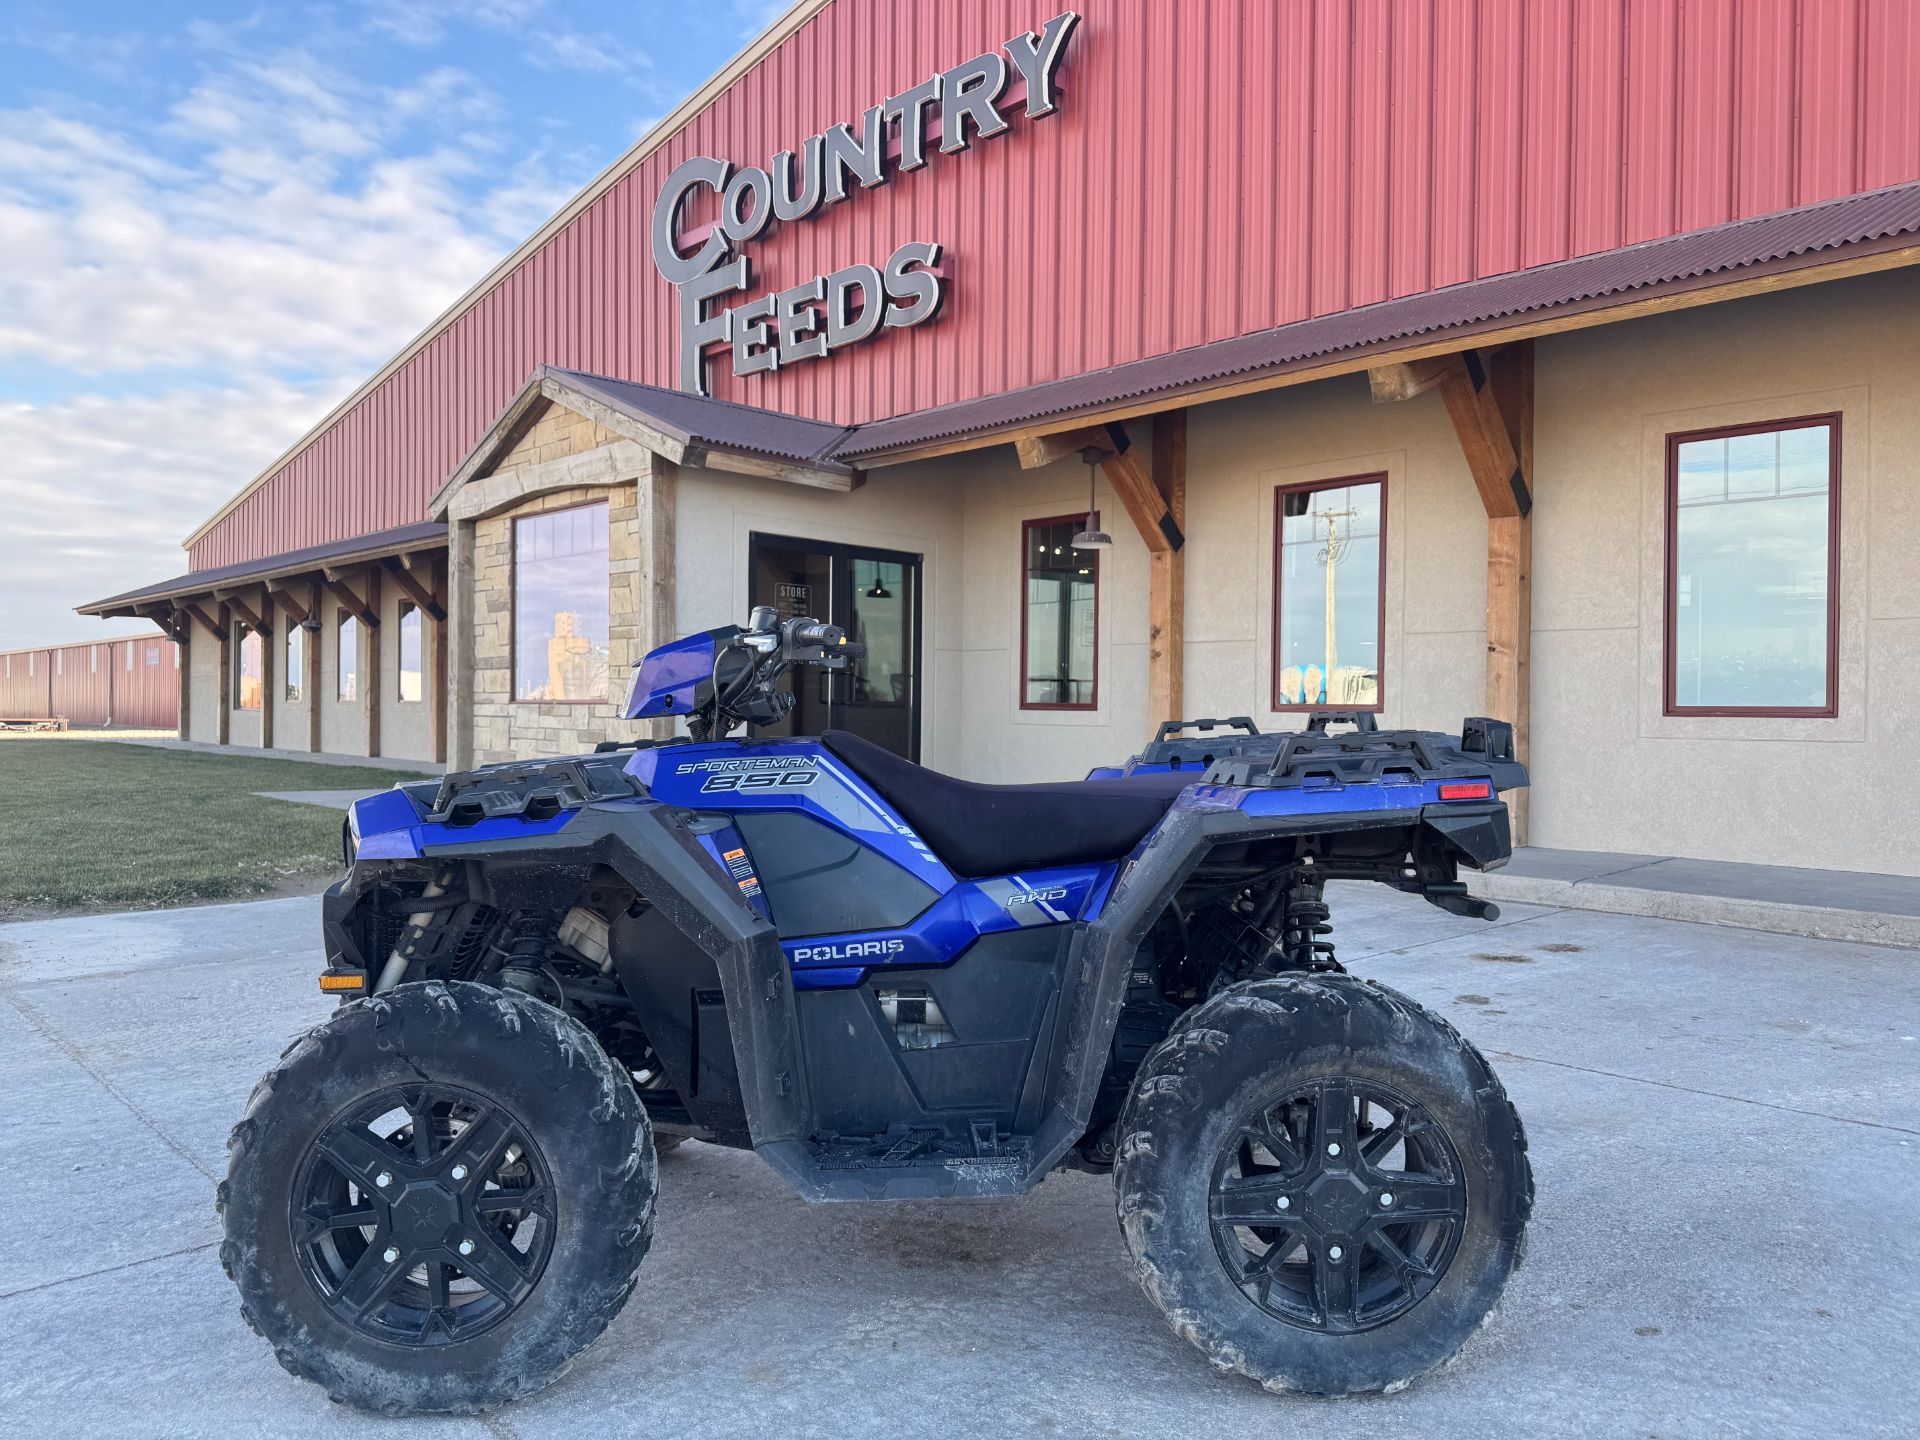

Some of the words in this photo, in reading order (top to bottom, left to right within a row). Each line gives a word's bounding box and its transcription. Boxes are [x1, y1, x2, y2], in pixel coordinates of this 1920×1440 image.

[652, 11, 1081, 284] COUNTRY
[678, 242, 943, 396] FEEDS
[780, 586, 807, 599] STORE
[676, 757, 819, 774] SPORTSMAN
[700, 770, 820, 793] 850
[1006, 889, 1067, 906] AWD
[794, 939, 905, 963] POLARIS
